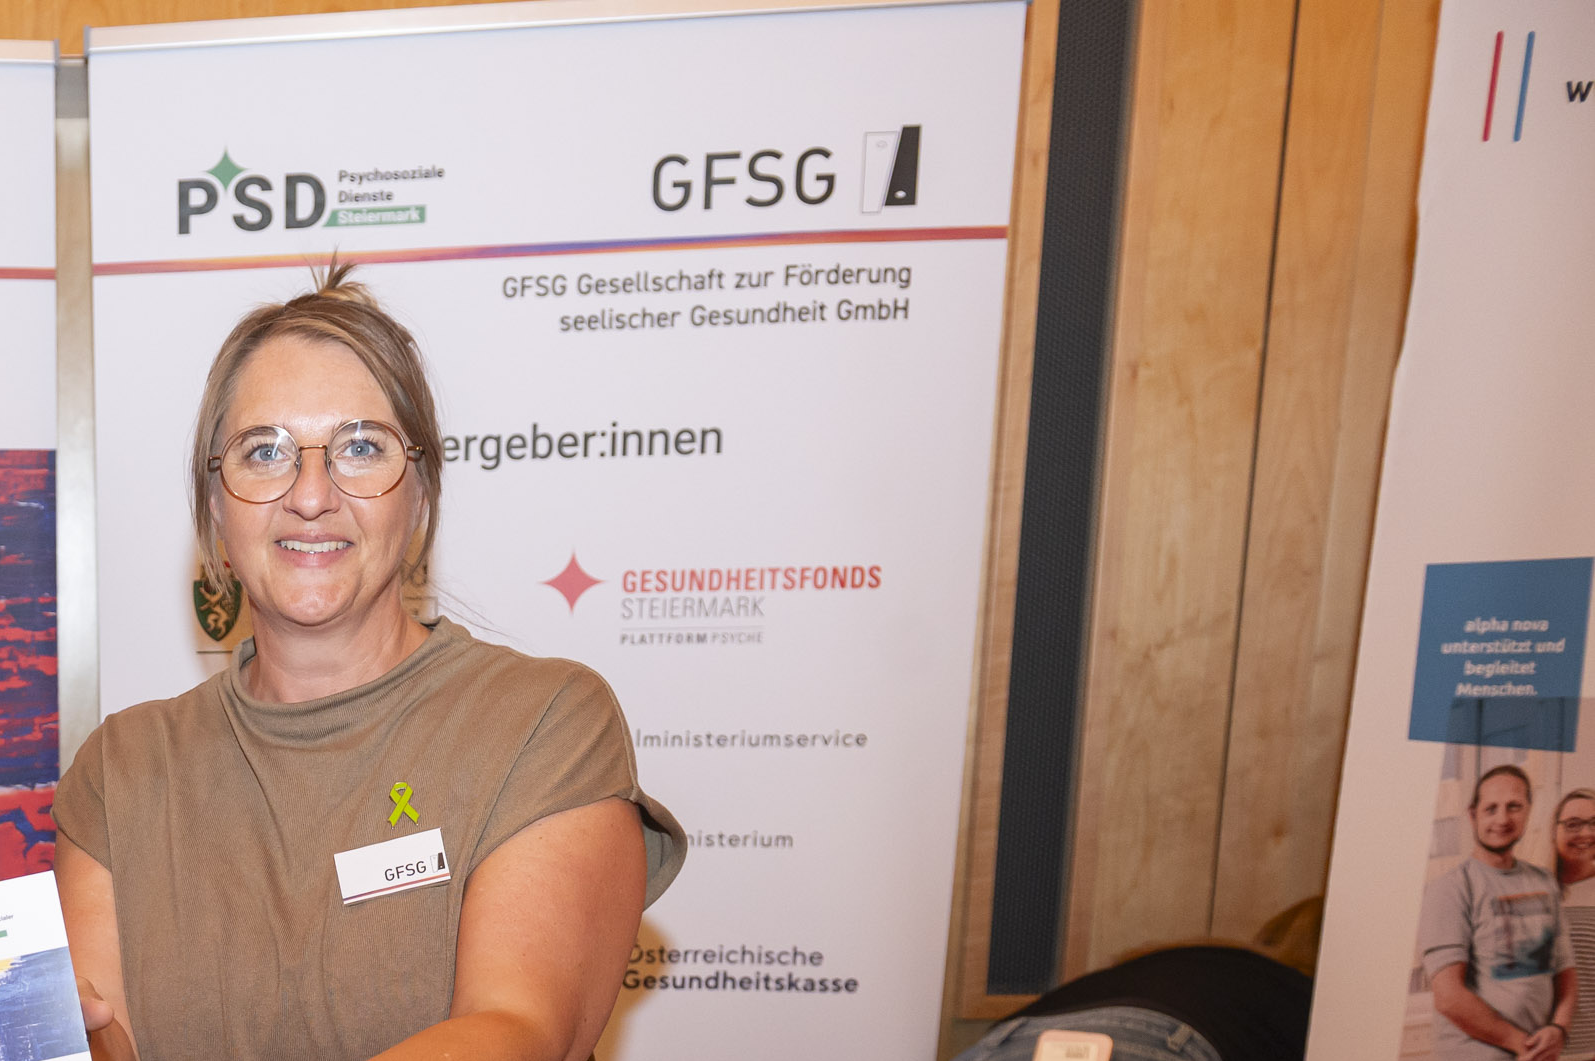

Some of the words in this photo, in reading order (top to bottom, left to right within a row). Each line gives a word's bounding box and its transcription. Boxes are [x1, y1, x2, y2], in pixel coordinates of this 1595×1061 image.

[338, 166, 445, 182] Psychosoziale
[652, 147, 836, 212] GFSG
[177, 172, 326, 235] PSD
[339, 189, 394, 203] Dienste
[337, 208, 421, 224] Steiermark
[503, 275, 567, 298] GFSG
[577, 269, 725, 296] Gesellschaft
[735, 269, 773, 289] zur
[785, 263, 912, 289] Förderung
[560, 307, 681, 332] seelischer
[691, 300, 826, 327] Gesundheit
[837, 298, 909, 321] GmbH
[623, 565, 882, 594] GESUNDHEITSFONDS
[621, 596, 765, 620] STEIERMARK
[1464, 617, 1508, 635] alpha
[1512, 619, 1548, 631] nova
[621, 633, 707, 645] PLATTFORM
[712, 632, 764, 644] PSYCHE
[1441, 639, 1532, 654] unterstützt
[1535, 638, 1566, 653] und
[1464, 660, 1536, 678] begleitet
[1456, 682, 1537, 696] Menschen.
[385, 861, 426, 881] GFSG
[627, 942, 824, 966] Österreichische
[623, 970, 859, 994] Gesundheitskasse
